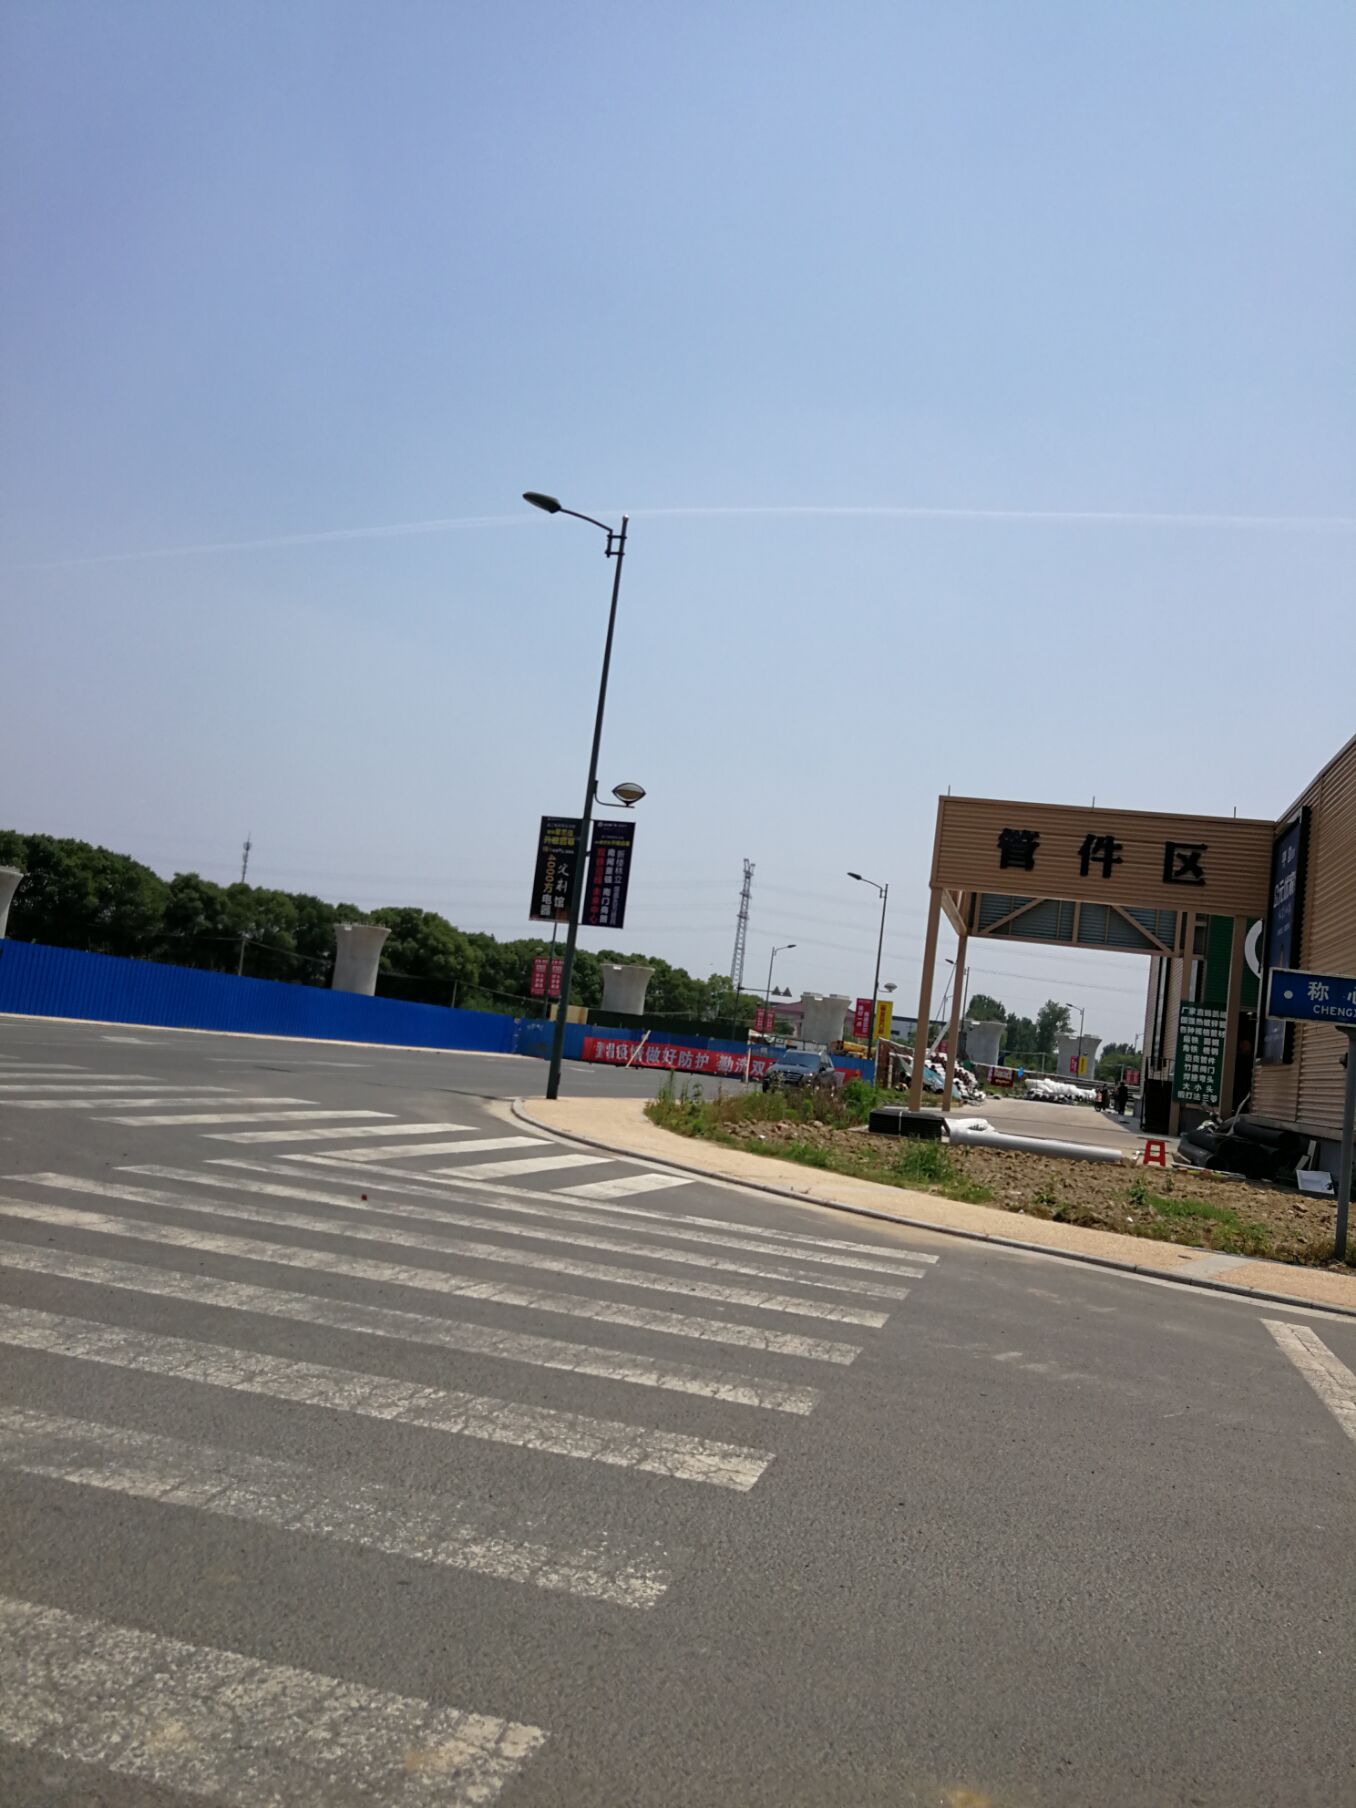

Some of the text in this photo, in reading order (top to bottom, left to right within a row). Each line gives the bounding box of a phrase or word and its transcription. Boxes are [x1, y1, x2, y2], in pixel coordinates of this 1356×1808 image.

[997, 827, 1209, 887] 管件区
[719, 1055, 771, 1078] 勤洗双
